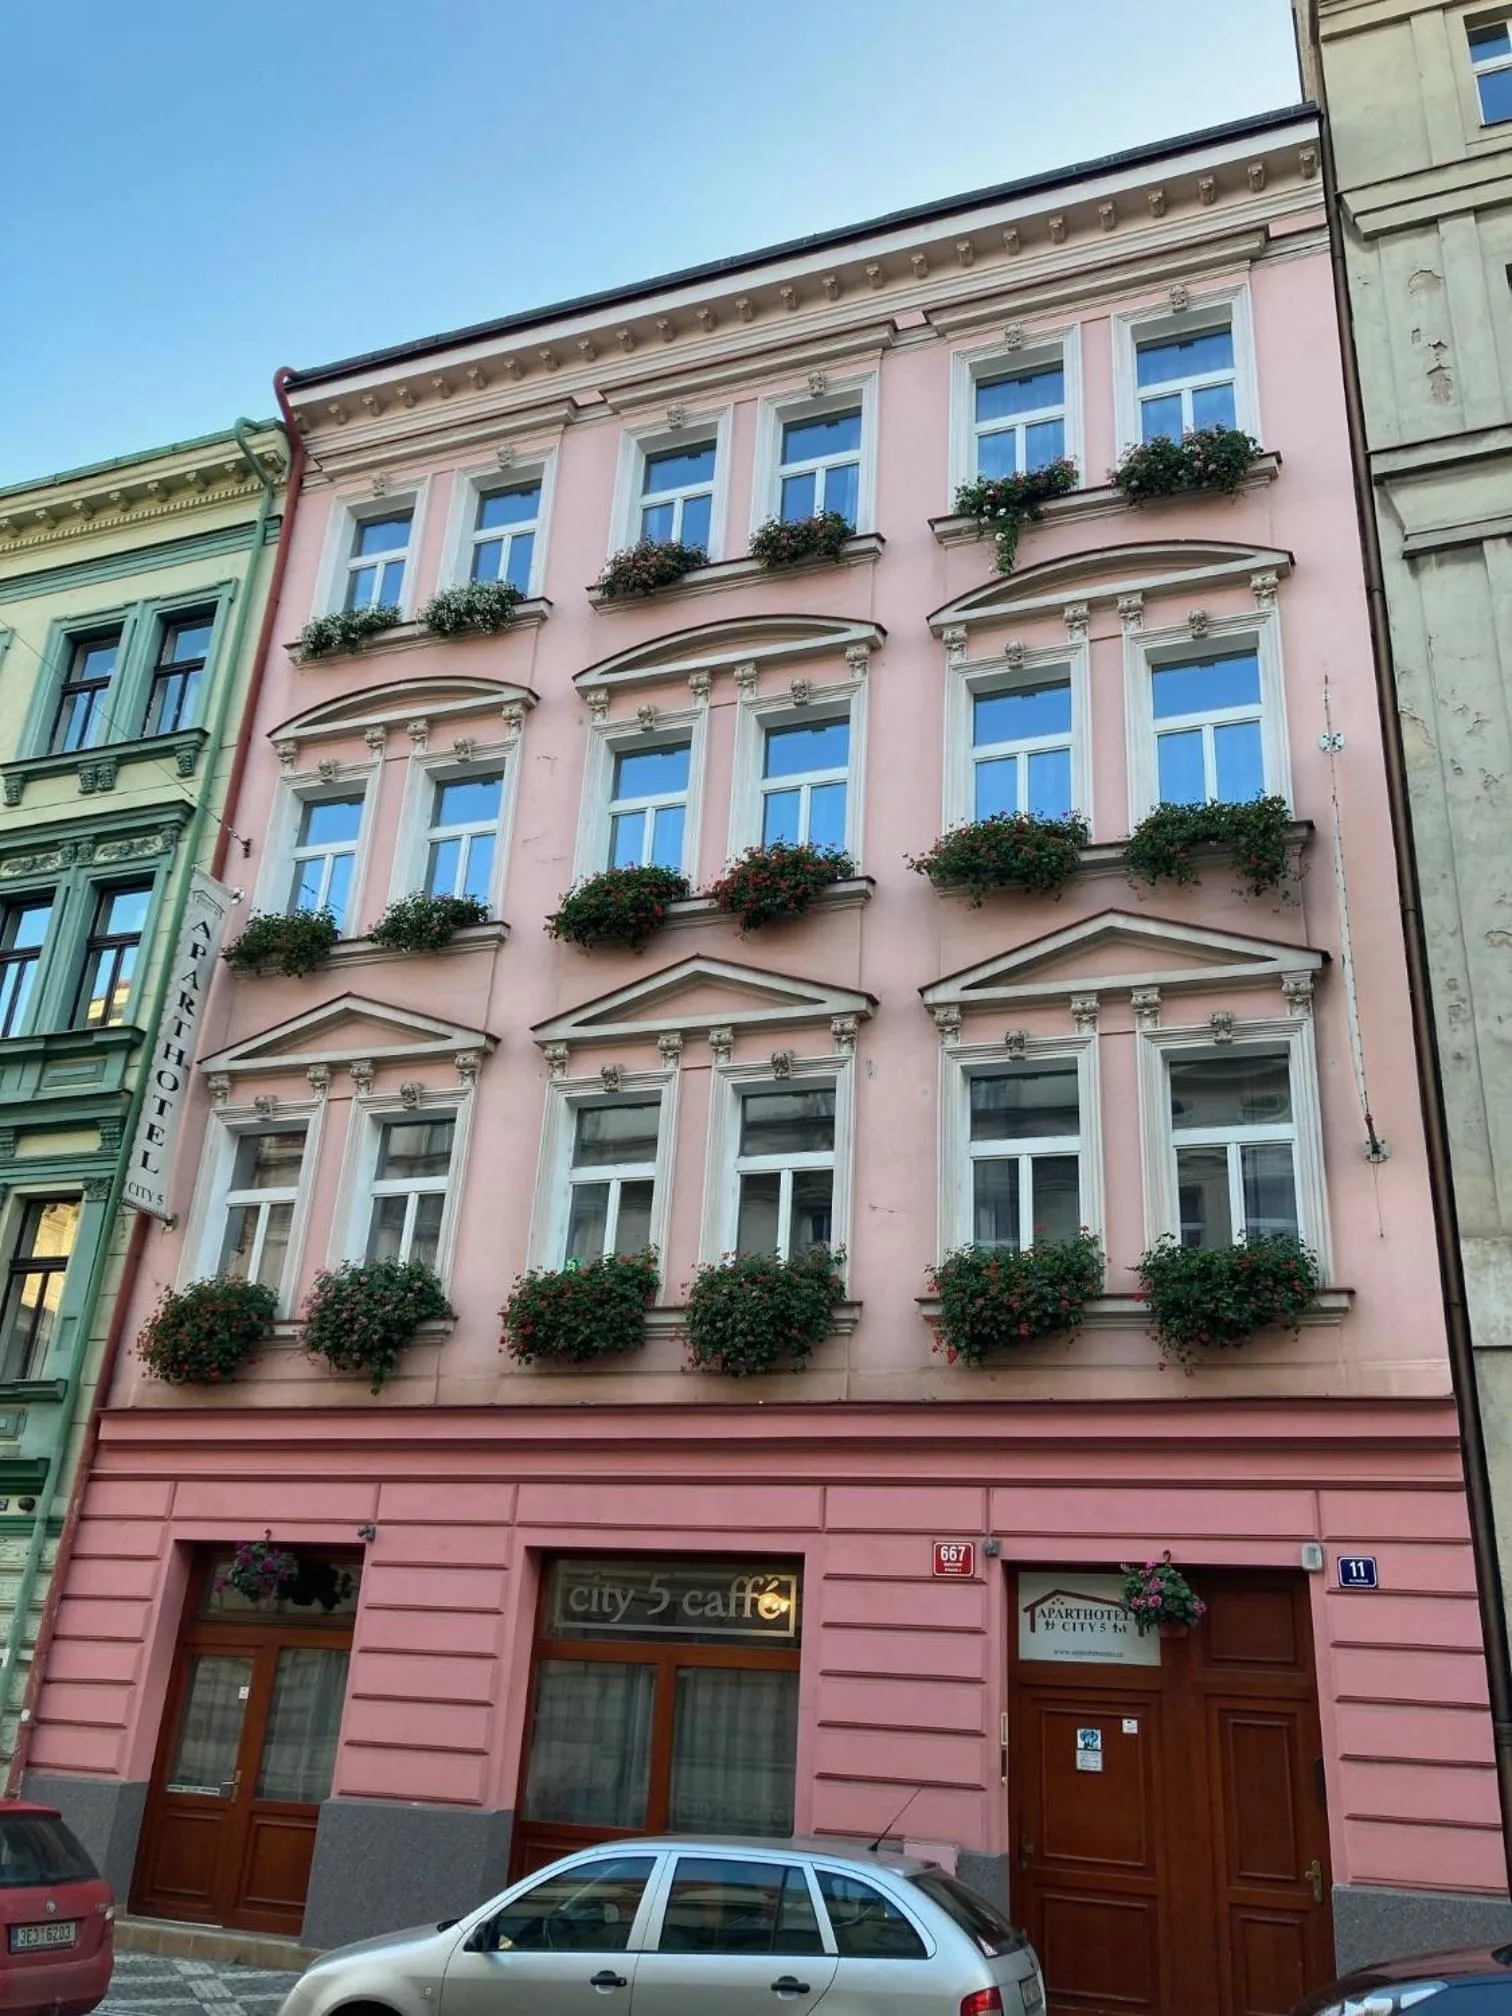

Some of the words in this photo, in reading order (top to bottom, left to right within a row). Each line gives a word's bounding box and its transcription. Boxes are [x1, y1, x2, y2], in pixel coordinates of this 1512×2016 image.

[139, 918, 213, 1175] APARTHOTEL
[128, 1182, 156, 1202] CITY
[156, 1194, 164, 1206] 5
[941, 1546, 966, 1561] 667
[1349, 1561, 1365, 1577] 11
[569, 1573, 635, 1623] city
[647, 1573, 673, 1615] 5
[682, 1575, 782, 1620] caffé
[1038, 1607, 1132, 1622] APARTHOTEL
[1062, 1621, 1096, 1633] CITY
[1099, 1623, 1107, 1633] 5
